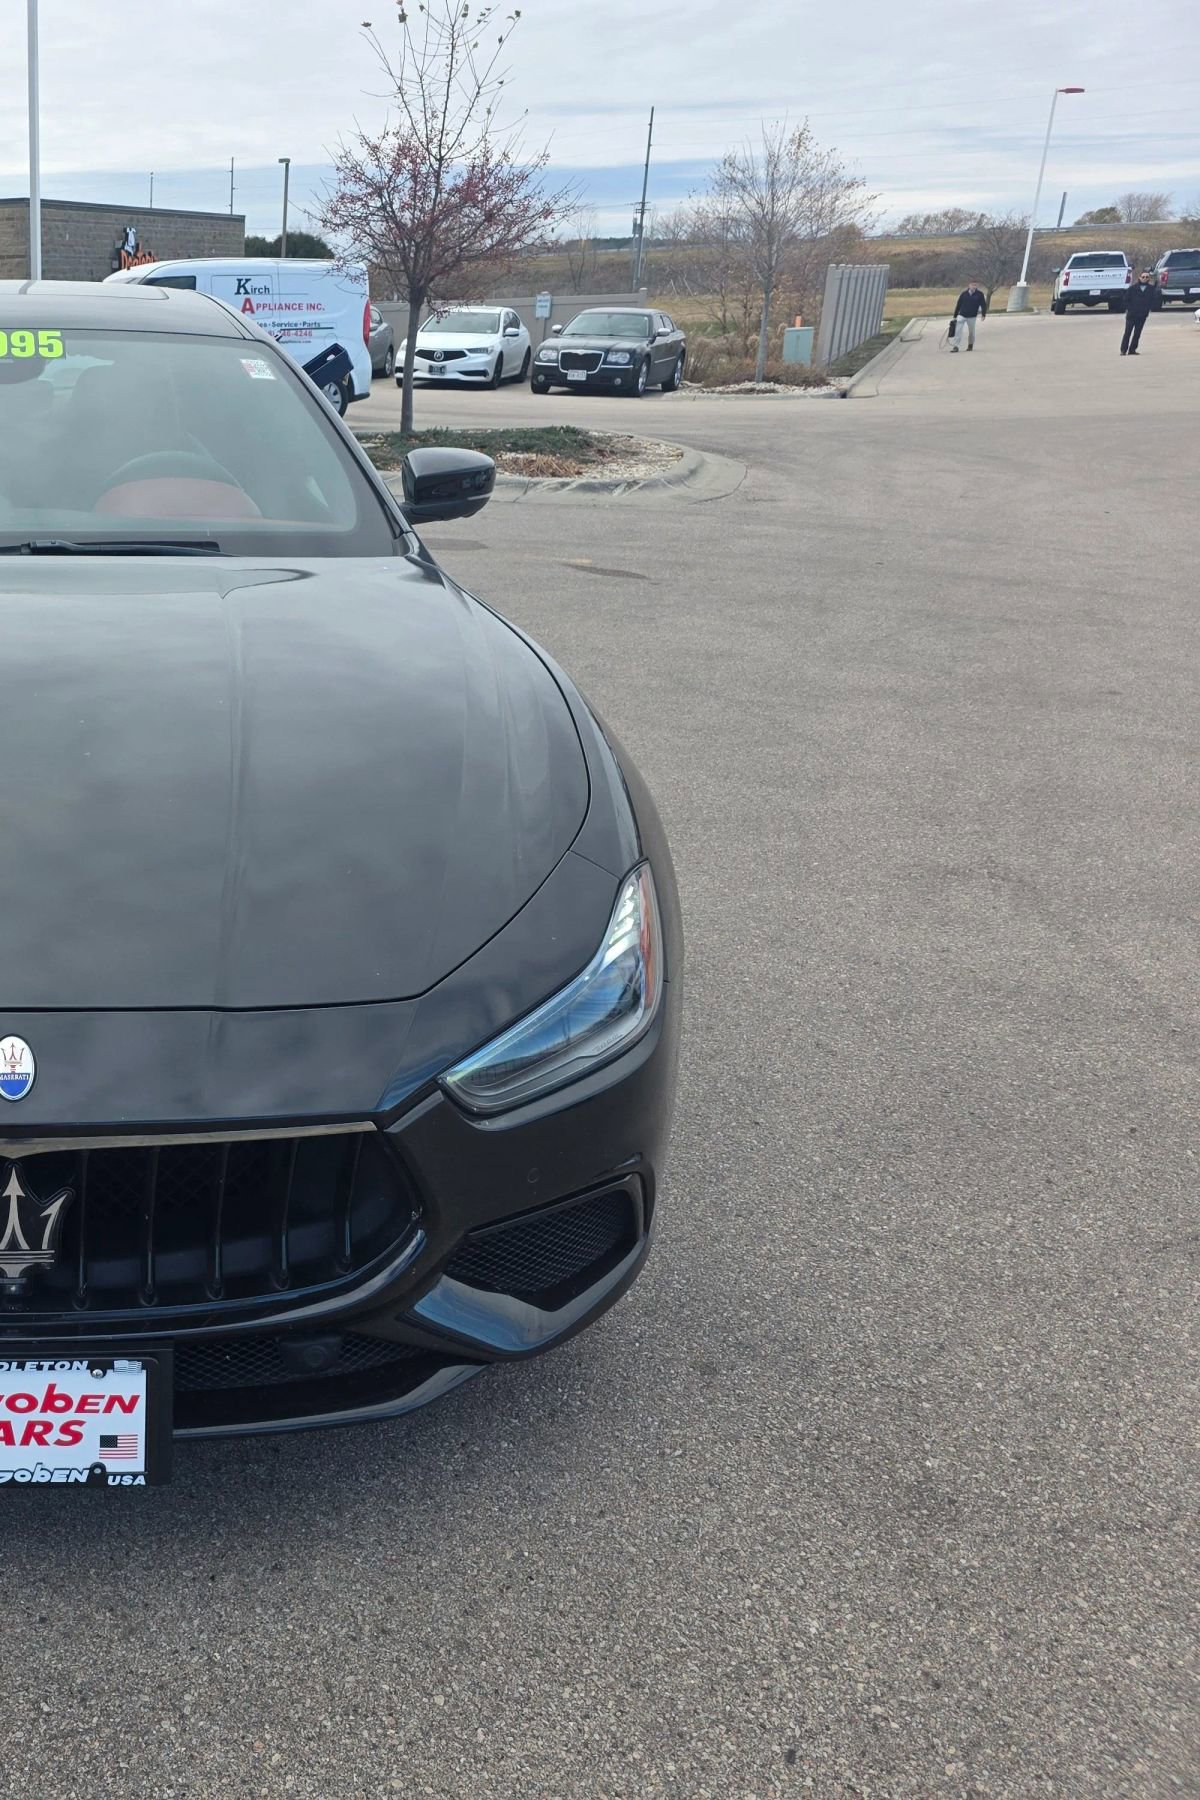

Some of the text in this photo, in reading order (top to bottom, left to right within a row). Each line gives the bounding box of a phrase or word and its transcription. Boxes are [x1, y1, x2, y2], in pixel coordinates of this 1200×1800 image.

[234, 278, 270, 295] Kirch
[241, 298, 325, 314] APPLIANCE INC.
[107, 1475, 146, 1486] USA
